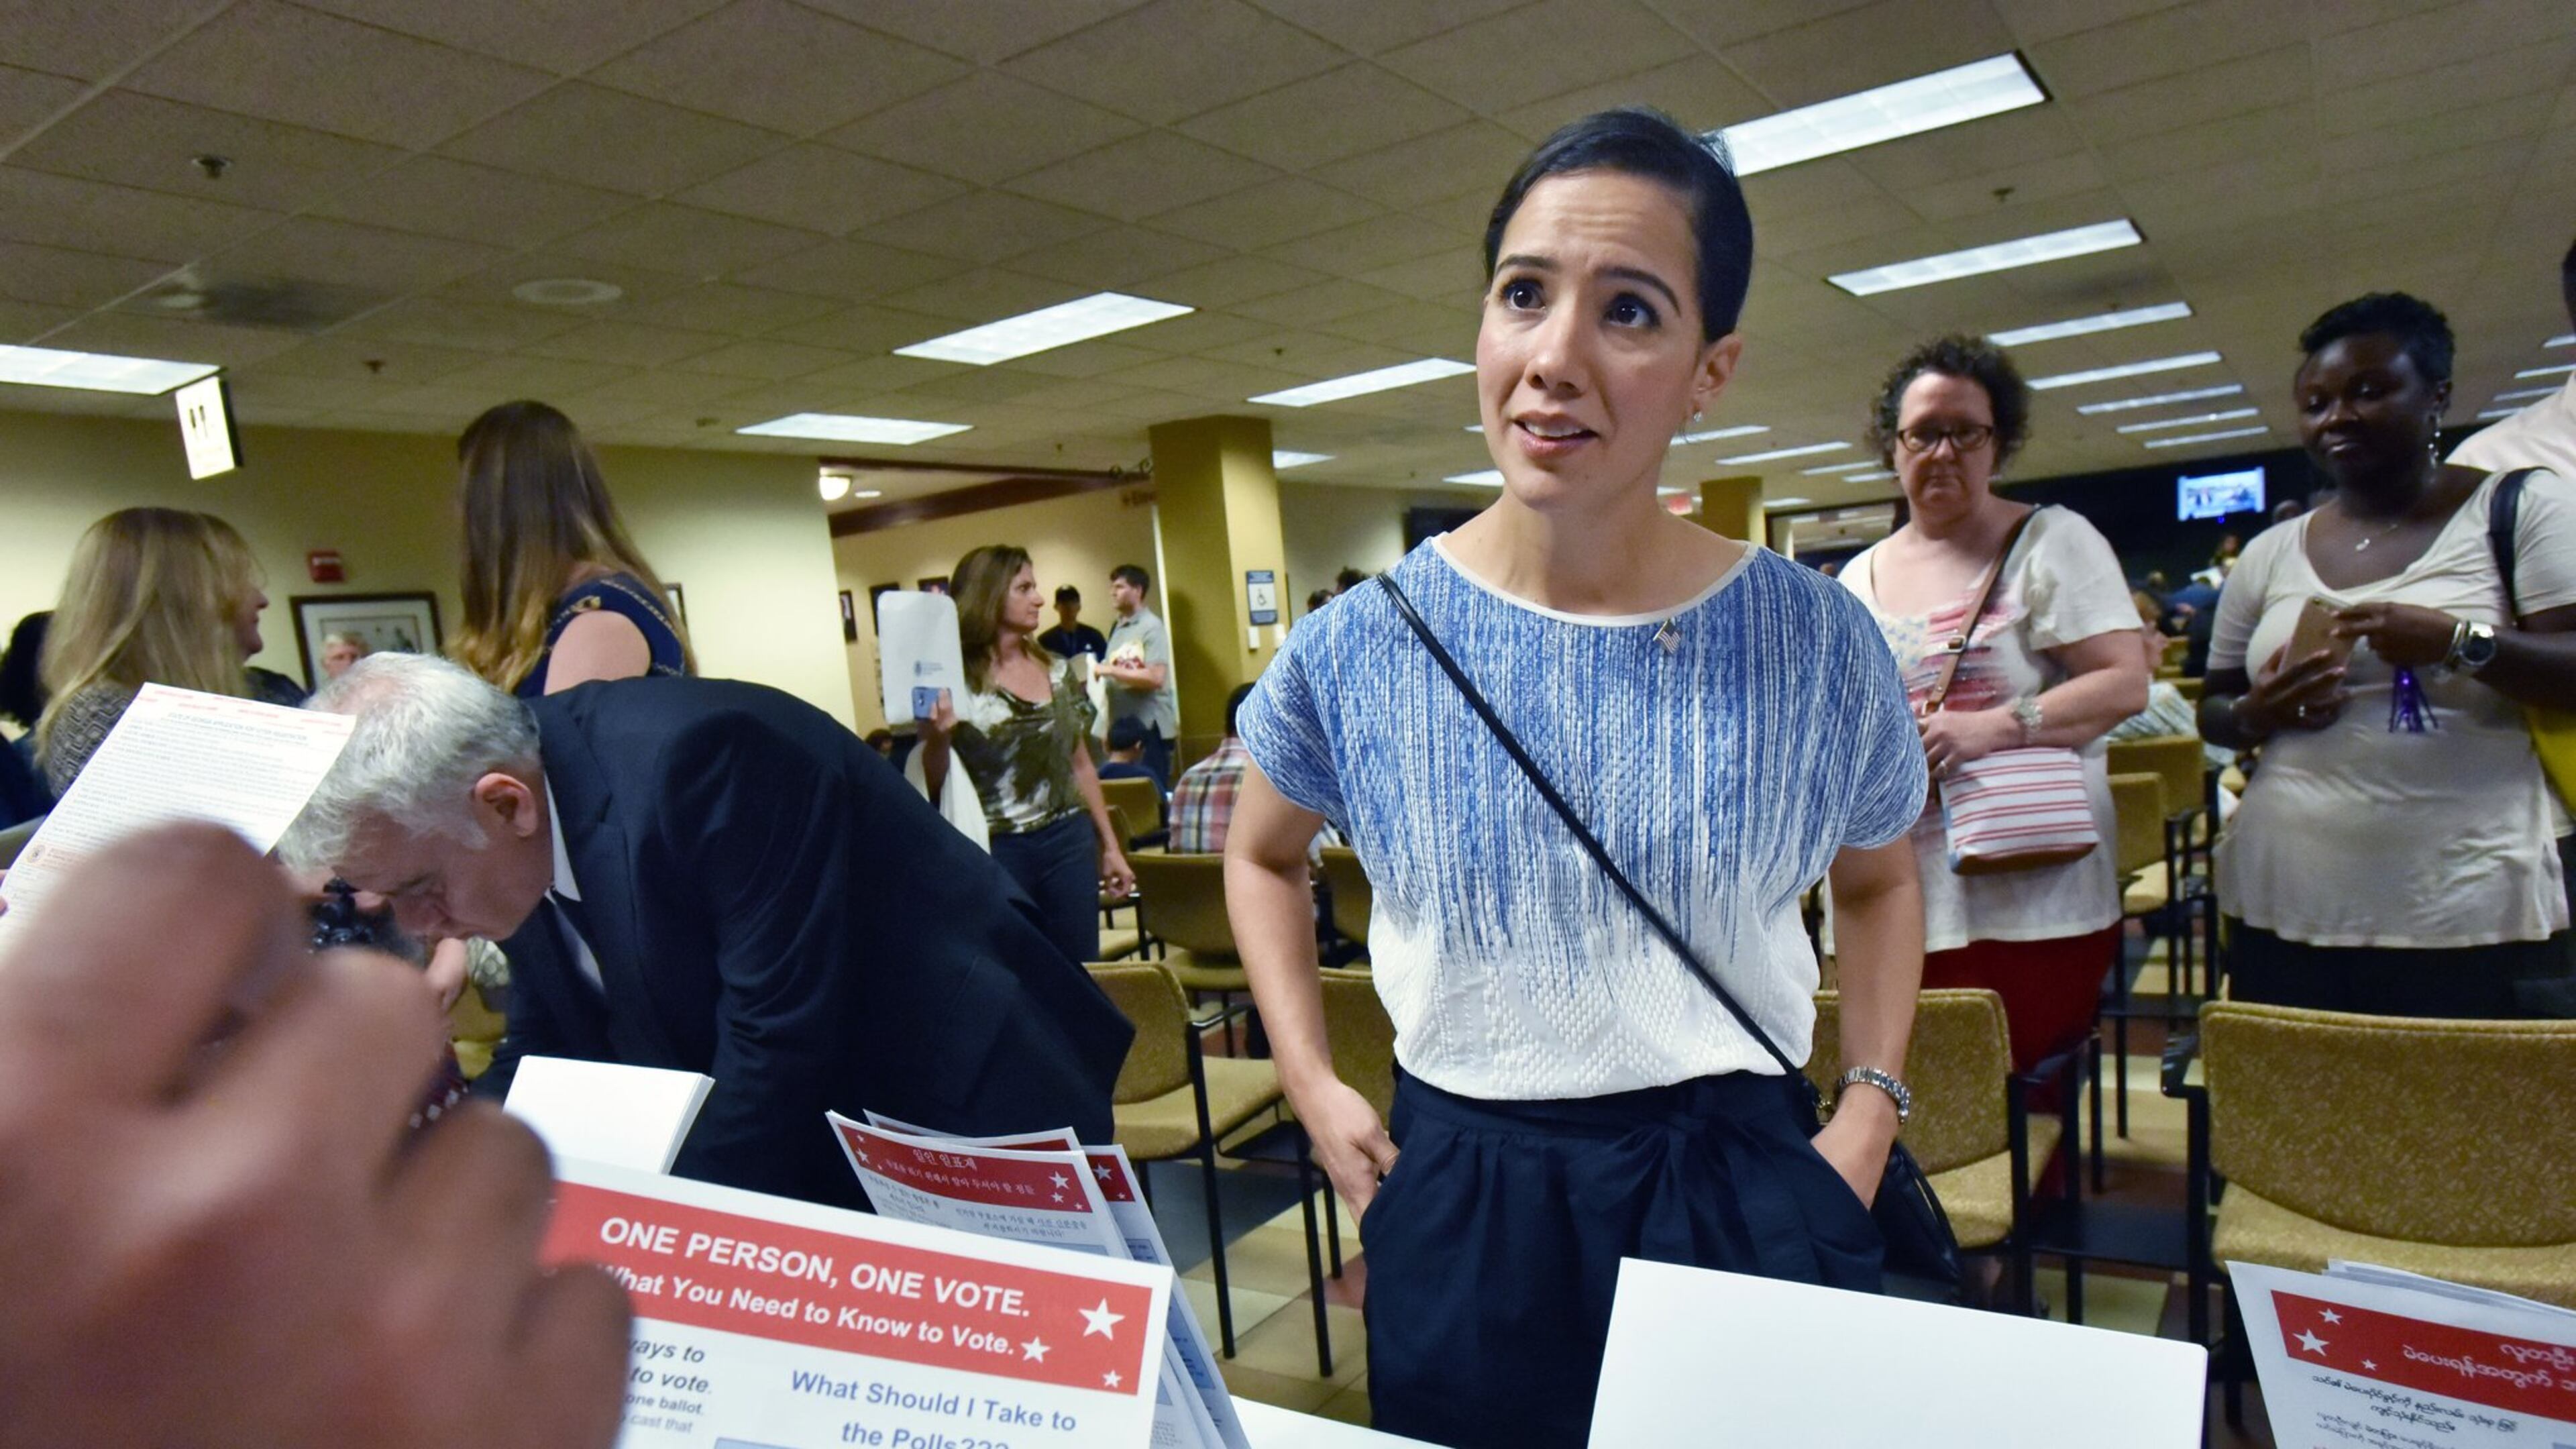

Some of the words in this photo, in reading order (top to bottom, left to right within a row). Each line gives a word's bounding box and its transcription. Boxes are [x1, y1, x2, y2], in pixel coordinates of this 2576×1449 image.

[600, 1217, 680, 1254] ONE
[685, 1232, 838, 1289] PERSON,
[850, 1263, 925, 1299] ONE
[934, 1277, 1030, 1318] VOTE.
[672, 1276, 724, 1305] You
[729, 1287, 800, 1319] Need
[804, 1302, 831, 1324] to
[837, 1306, 913, 1338] Know
[918, 1321, 944, 1342] to
[951, 1326, 1015, 1355] Vote.
[683, 1346, 706, 1364] to
[630, 1366, 654, 1384] to
[661, 1371, 712, 1395] vote.
[791, 1370, 858, 1400] What
[867, 1382, 960, 1415] Should
[967, 1399, 975, 1417] I
[984, 1399, 1044, 1428] Take
[1052, 1411, 1077, 1432] to
[841, 1421, 883, 1446] the
